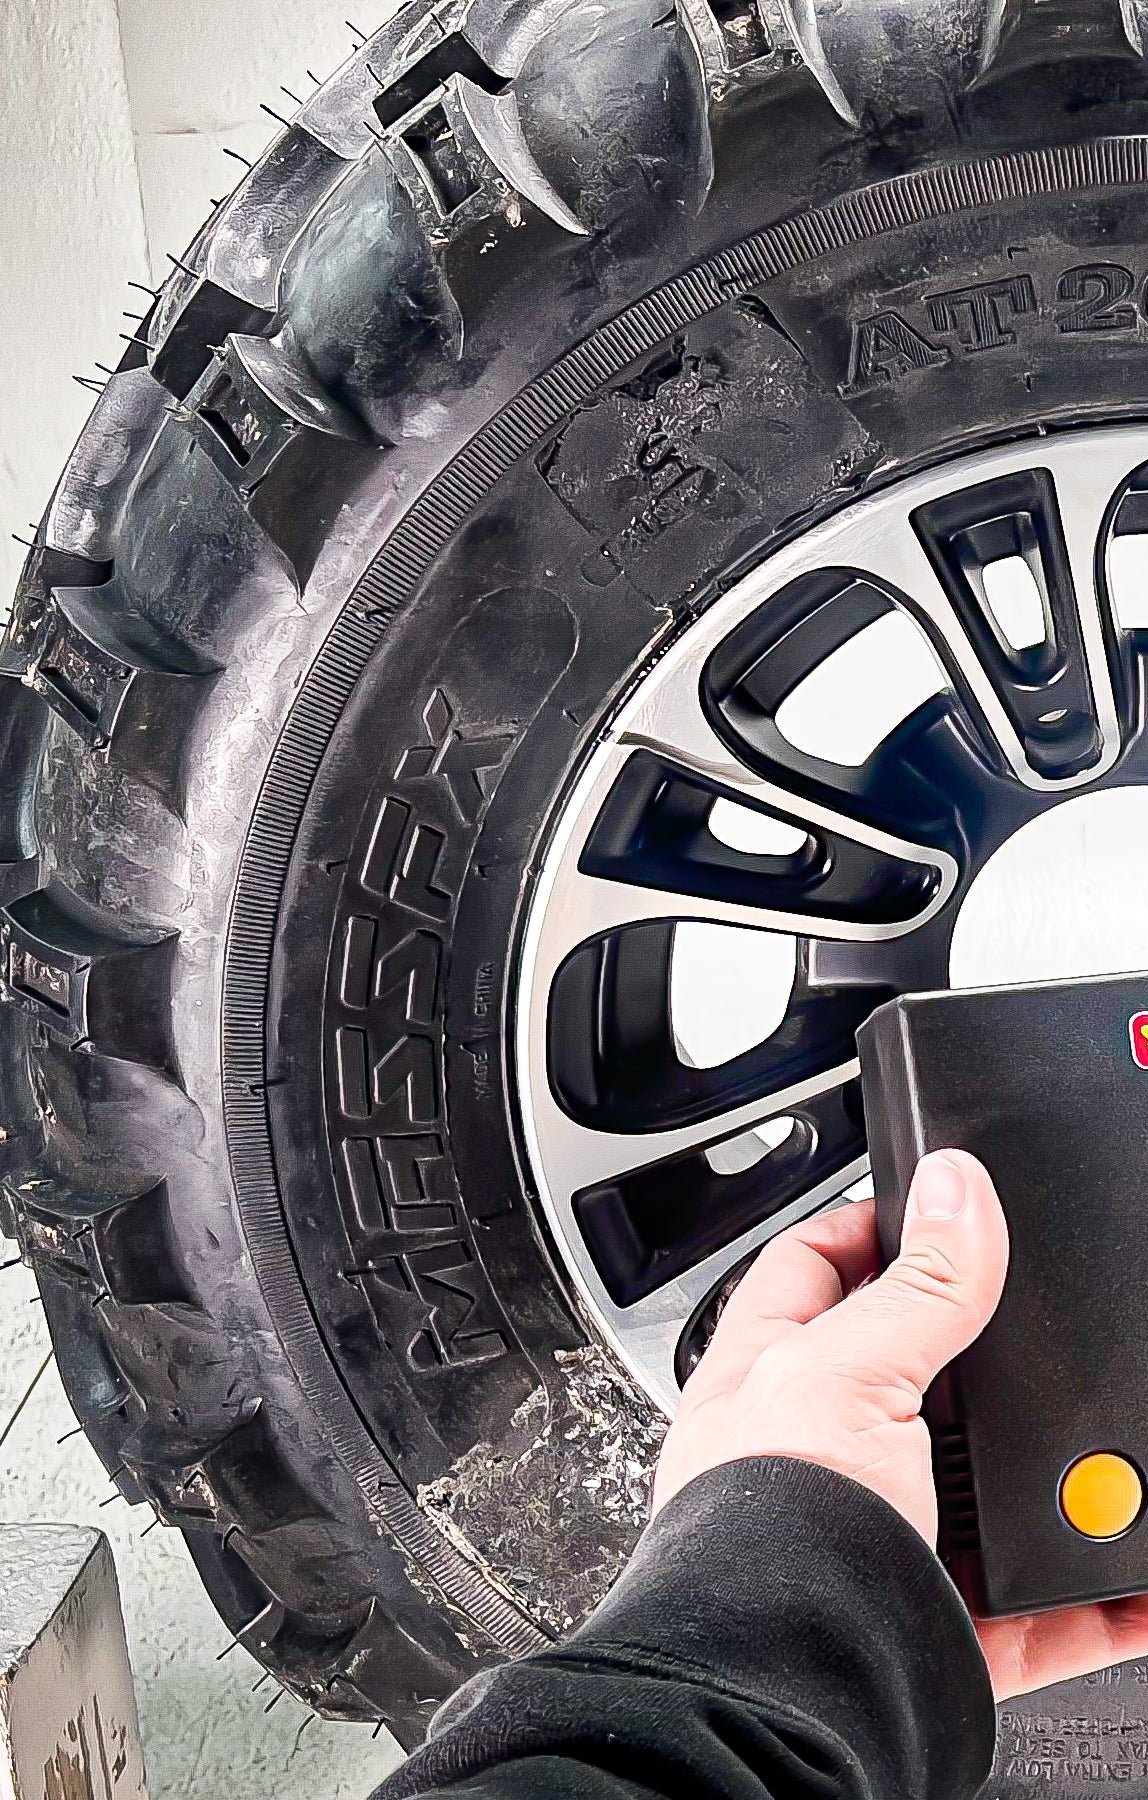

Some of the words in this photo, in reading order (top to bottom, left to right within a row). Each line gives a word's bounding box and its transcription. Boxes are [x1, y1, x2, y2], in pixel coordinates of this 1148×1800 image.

[836, 270, 1037, 398] AT
[337, 686, 518, 1374] MASSFX
[1006, 1758, 1054, 1781] LOW
